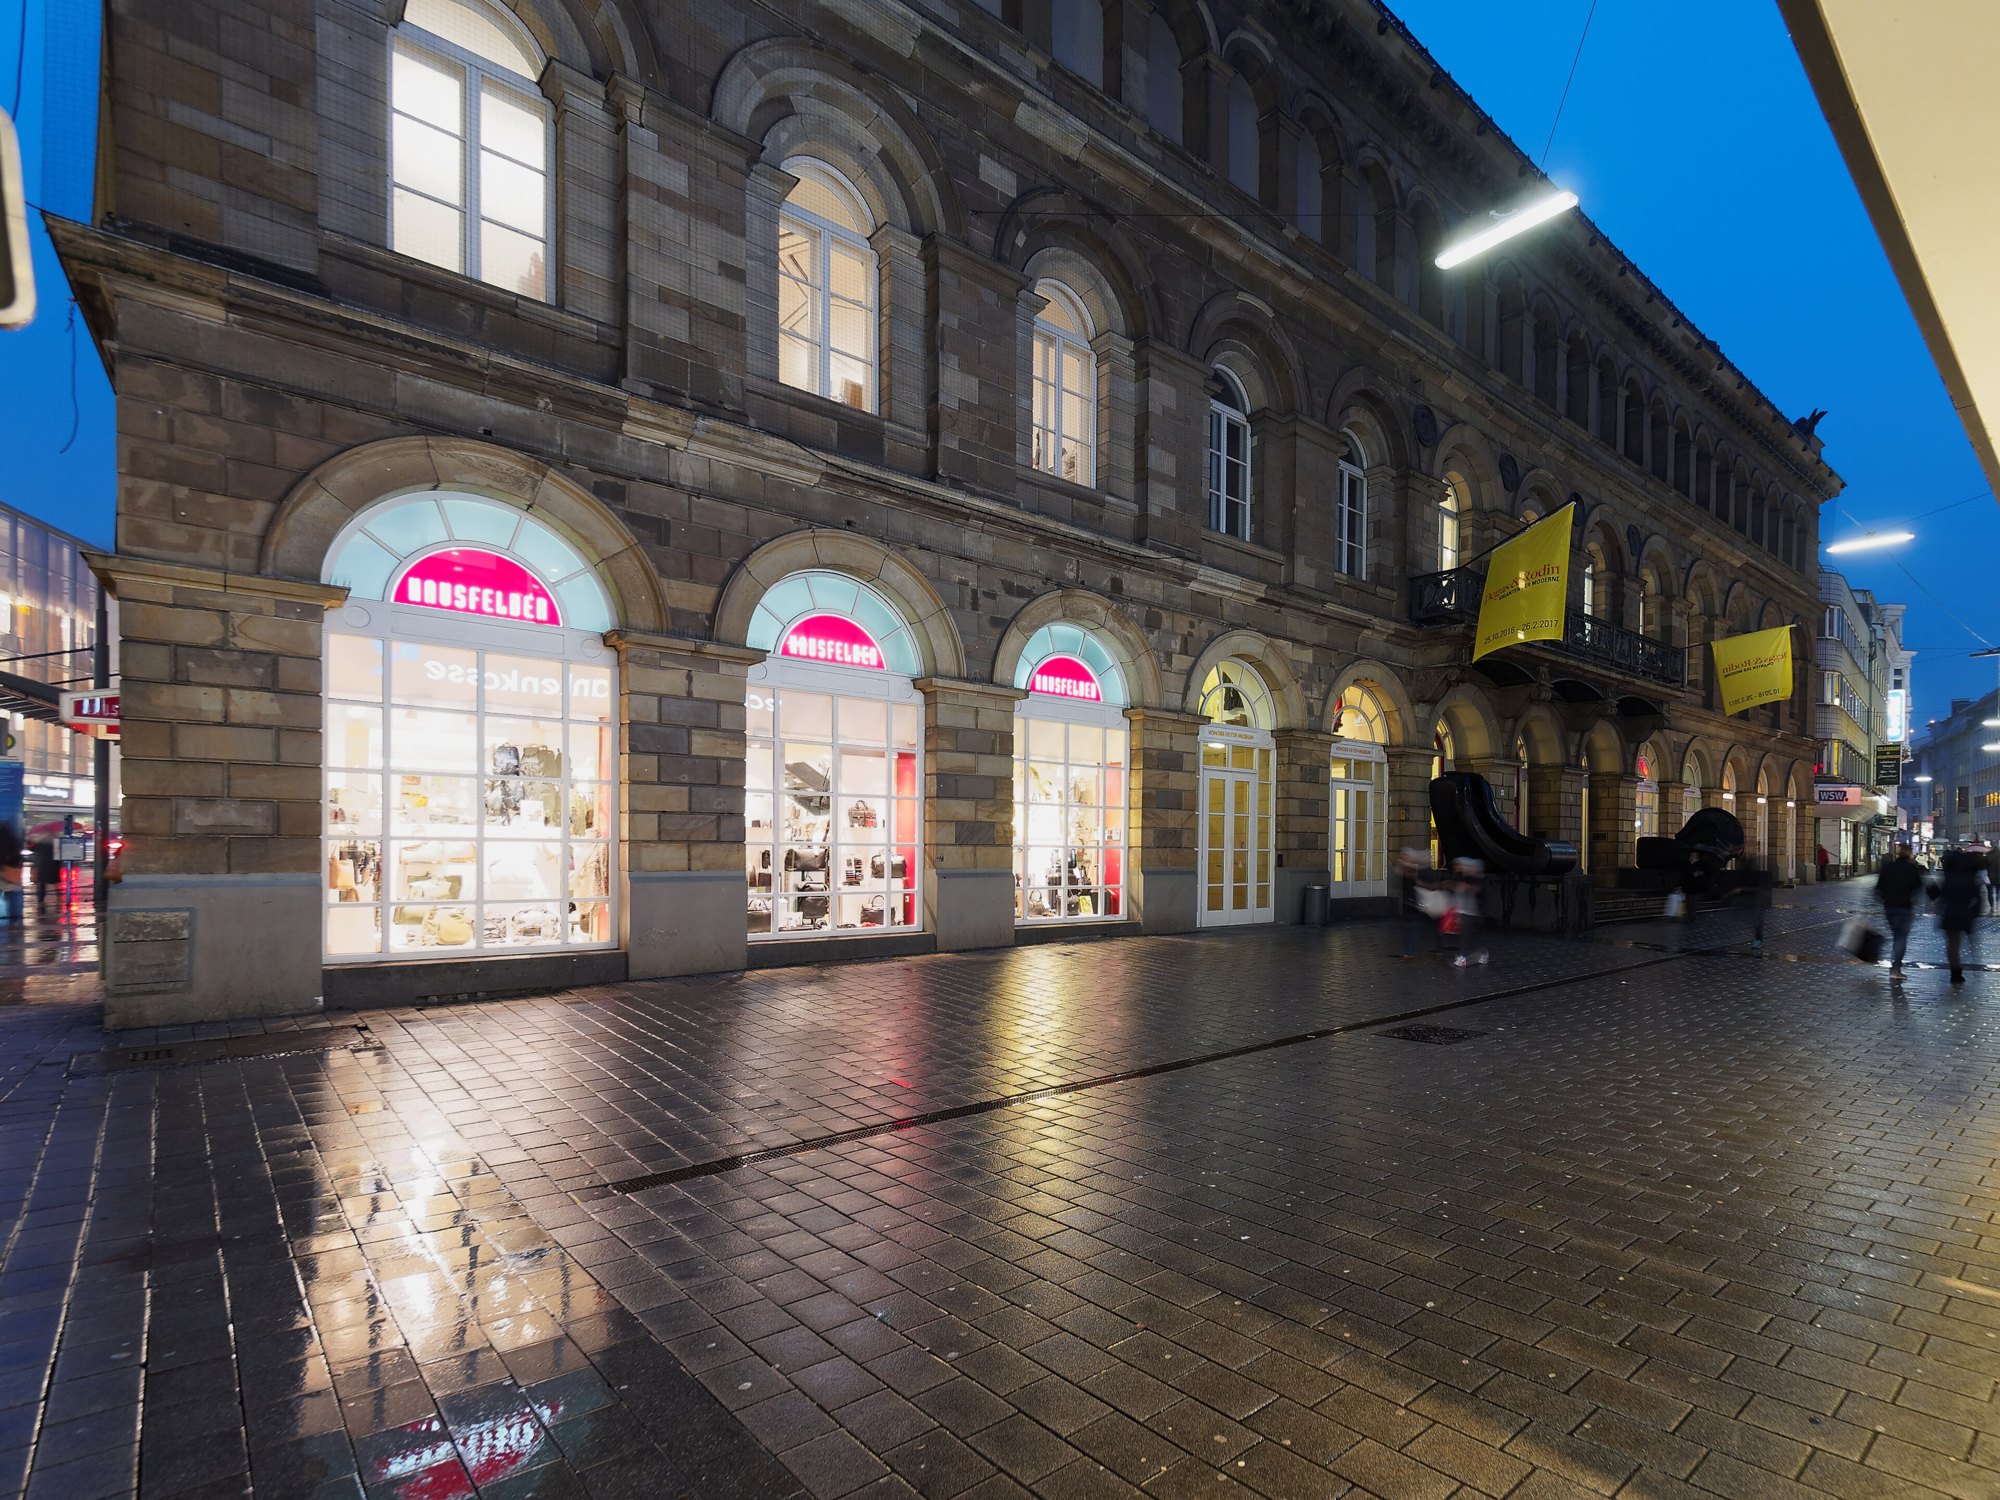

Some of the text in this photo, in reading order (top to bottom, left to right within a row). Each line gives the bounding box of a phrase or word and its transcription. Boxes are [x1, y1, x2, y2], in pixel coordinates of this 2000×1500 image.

[1520, 564, 1560, 582] Rodin
[1531, 576, 1560, 586] MODERNE
[408, 576, 549, 621] HAUSFELDER
[1484, 626, 1516, 645] 25.10.2016
[1521, 619, 1559, 632] 26.2.2017
[788, 635, 878, 667] HAUSFELDER
[1035, 673, 1097, 699] HAUSFELDER
